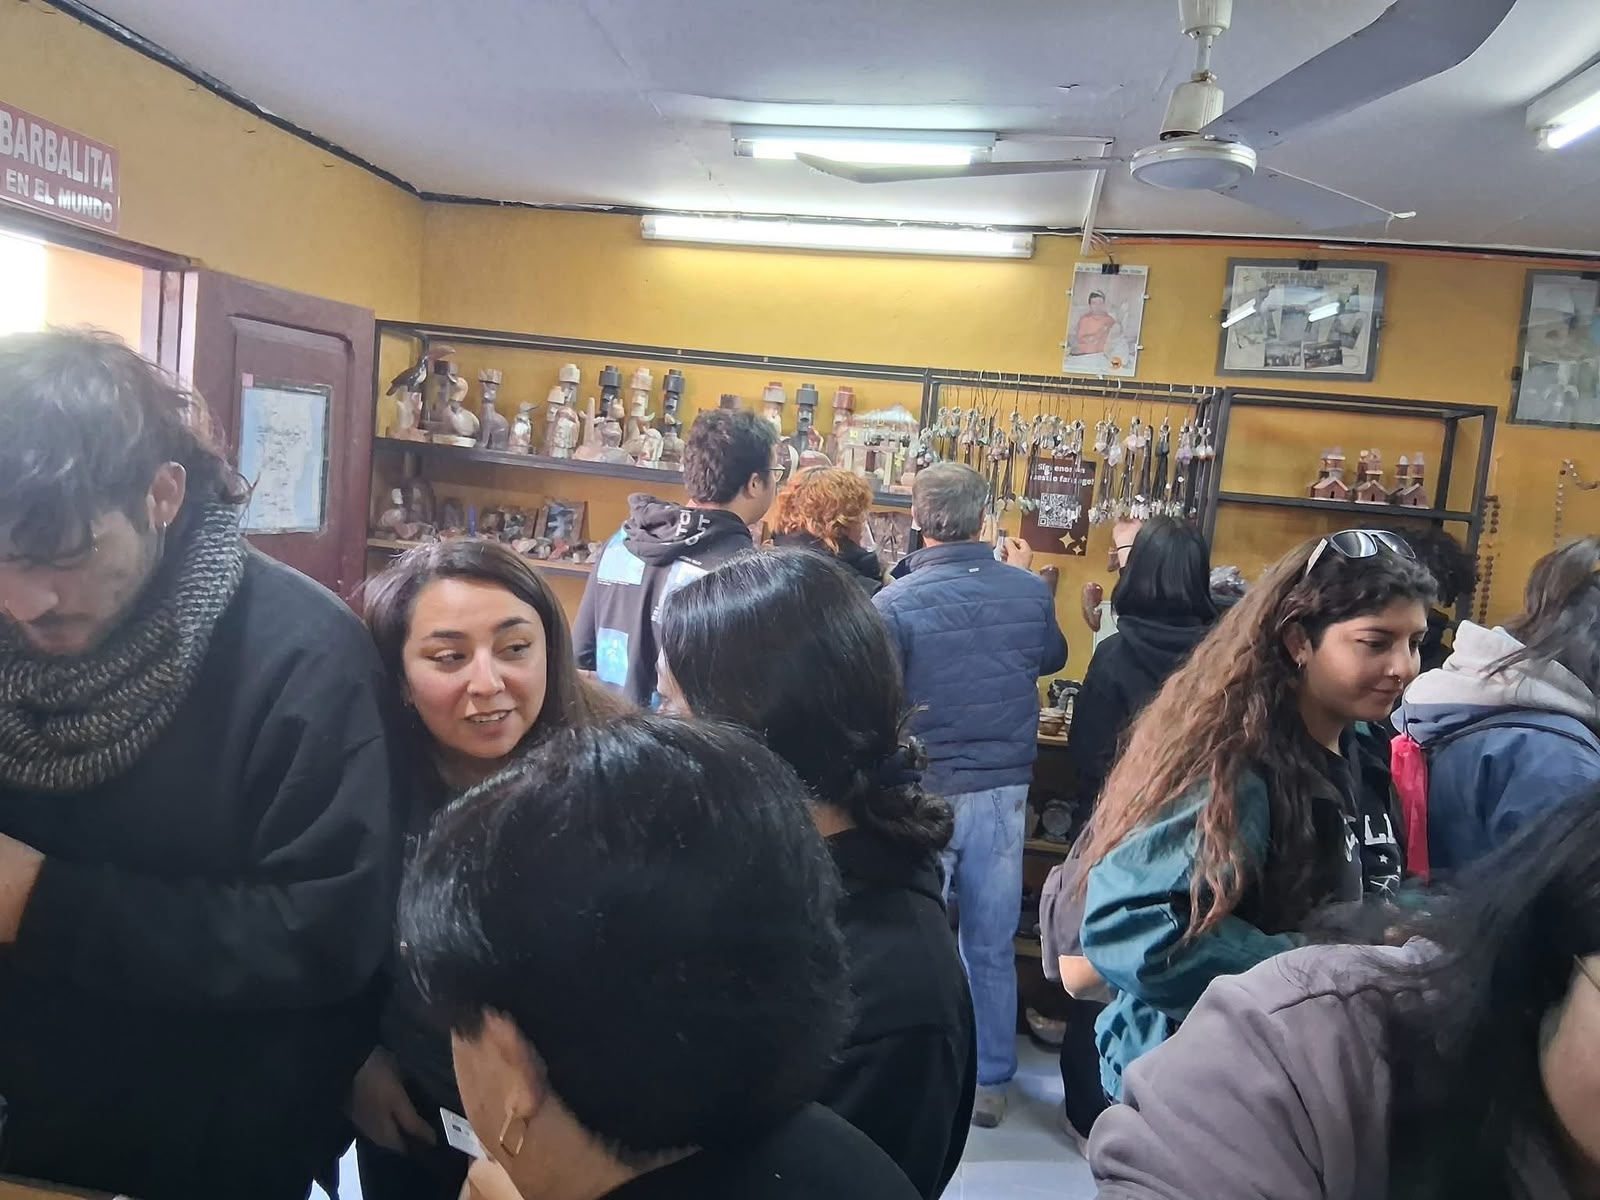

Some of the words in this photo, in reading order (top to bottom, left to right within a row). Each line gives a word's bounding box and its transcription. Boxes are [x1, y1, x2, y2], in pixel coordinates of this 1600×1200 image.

[0, 109, 113, 193] BARBALITA
[6, 168, 29, 196] EN
[34, 178, 55, 206] EL
[58, 187, 113, 224] MUNDO
